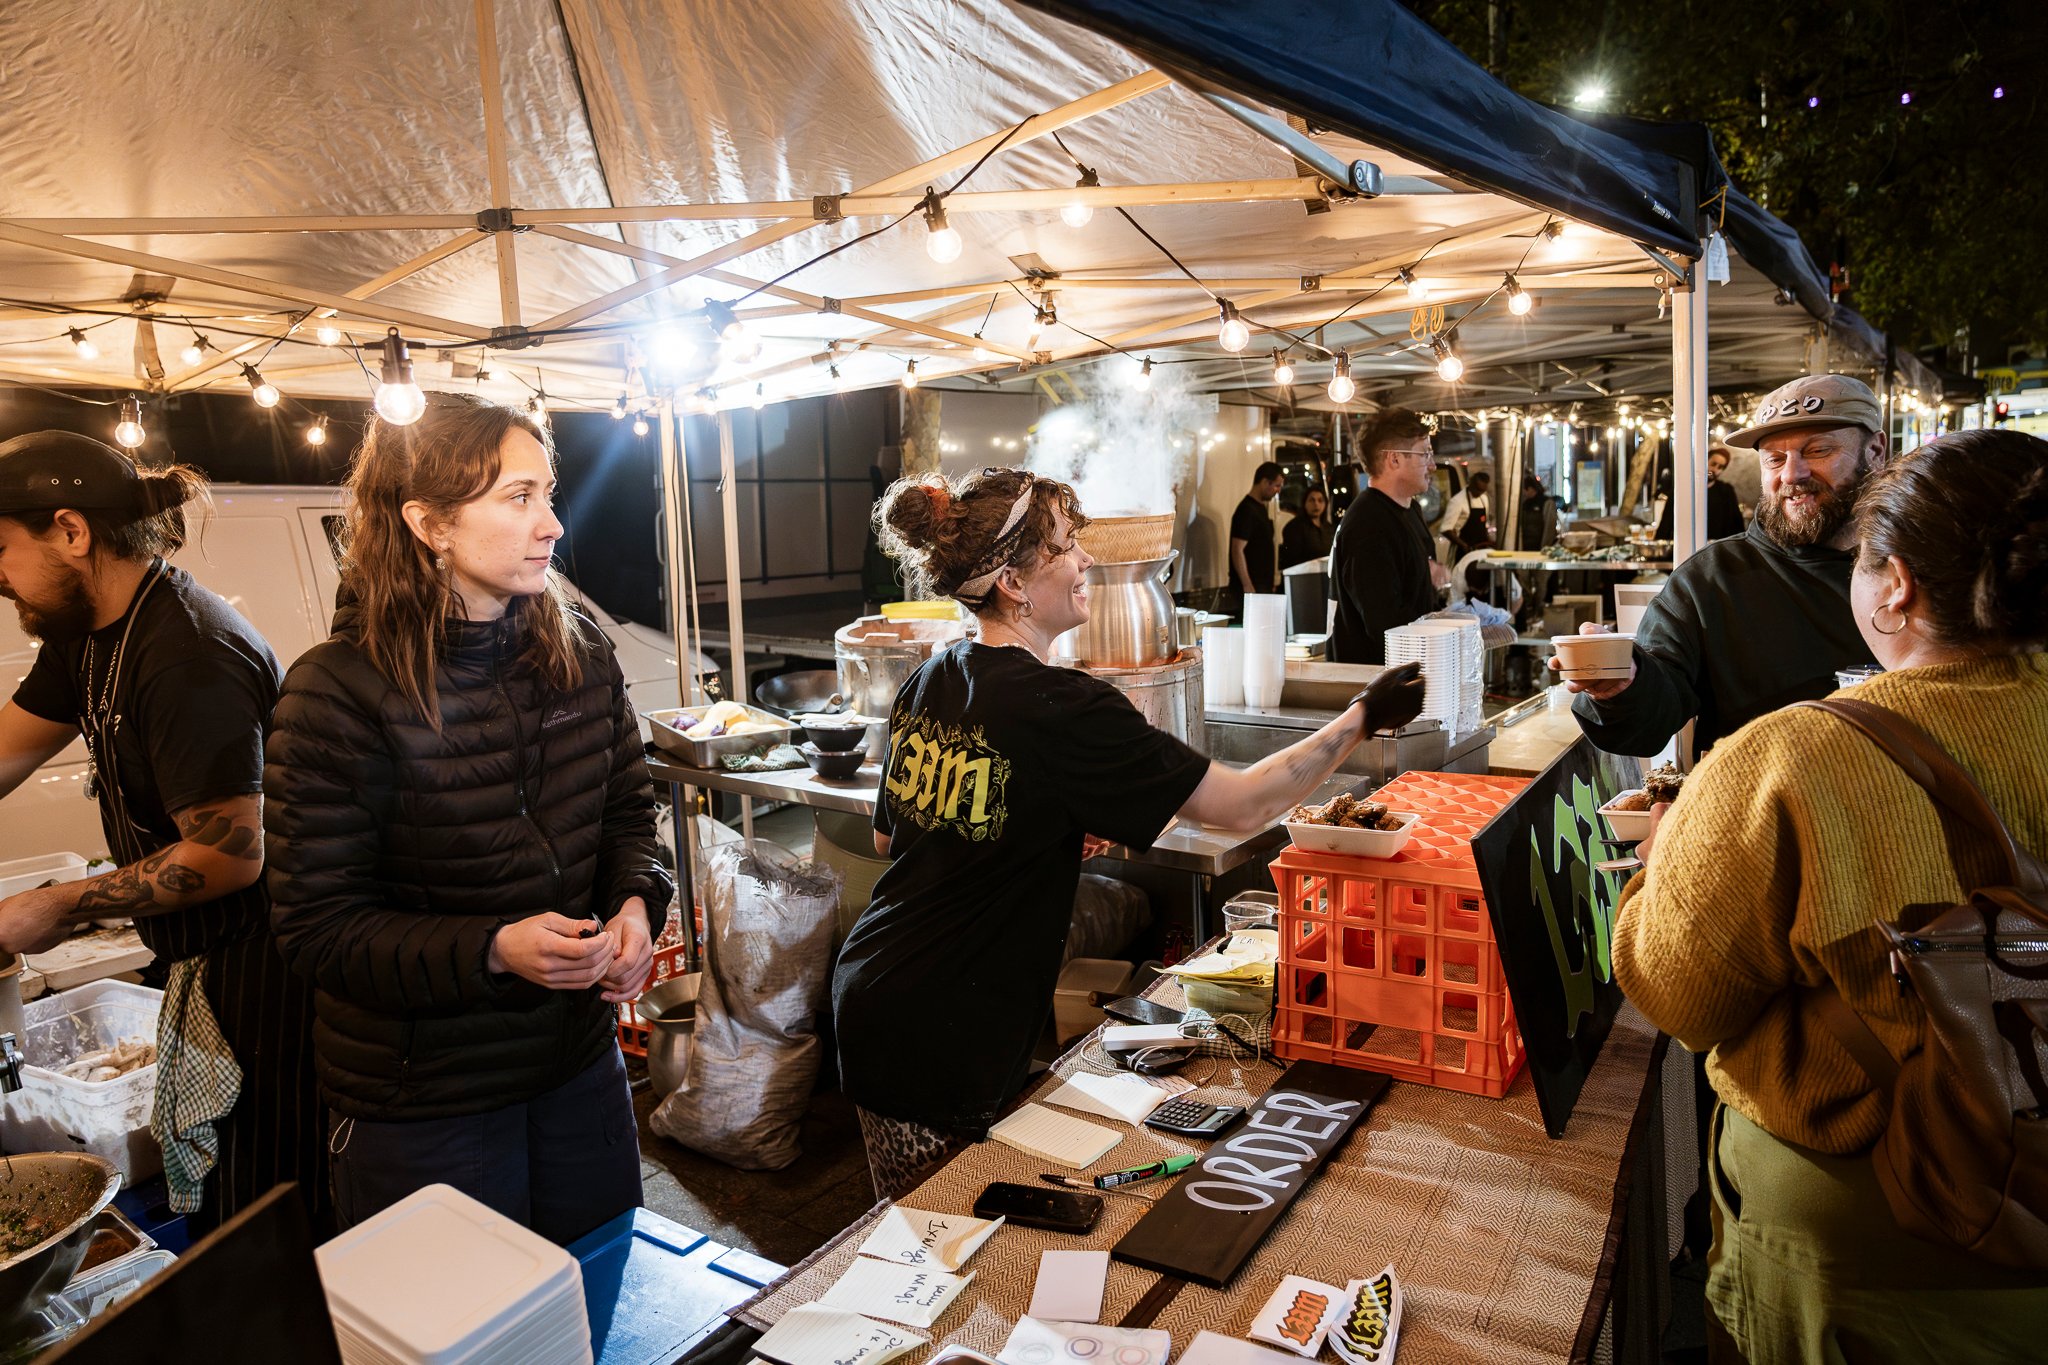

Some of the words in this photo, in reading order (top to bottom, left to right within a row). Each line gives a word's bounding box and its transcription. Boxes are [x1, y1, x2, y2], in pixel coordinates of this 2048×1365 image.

[1760, 394, 1825, 424] ゆとり
[541, 711, 582, 729] Kathmandu
[1185, 1092, 1360, 1211] ORDER
